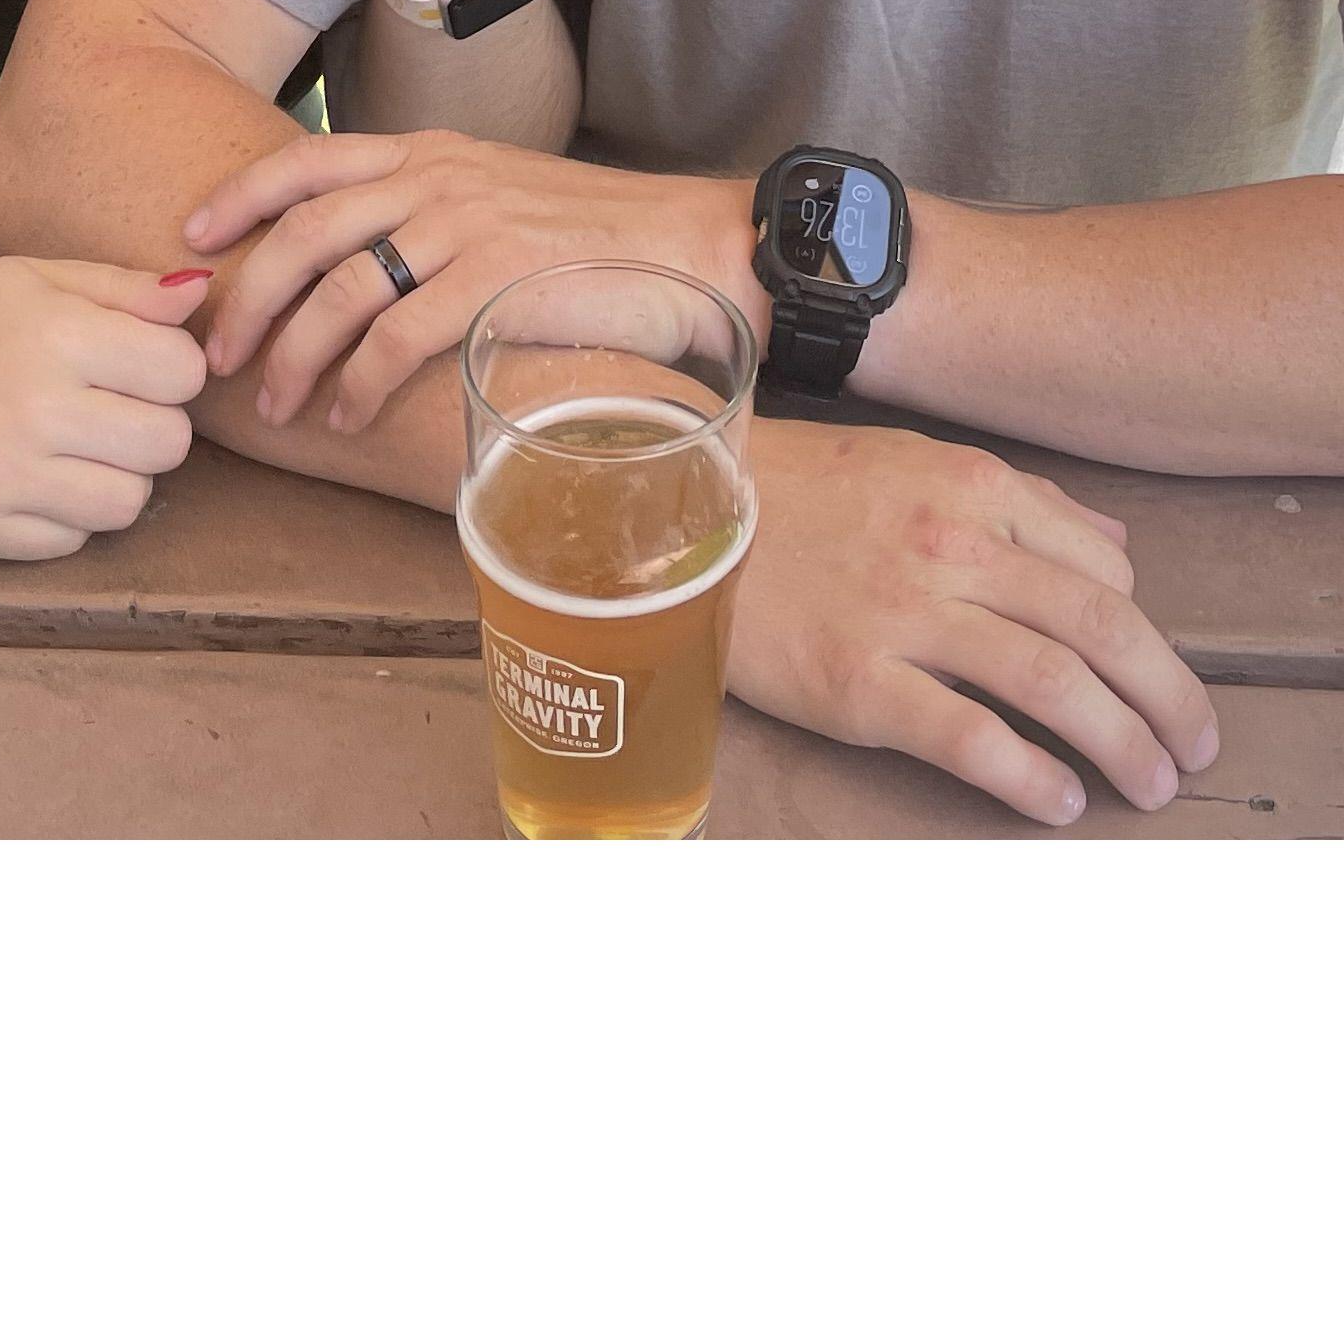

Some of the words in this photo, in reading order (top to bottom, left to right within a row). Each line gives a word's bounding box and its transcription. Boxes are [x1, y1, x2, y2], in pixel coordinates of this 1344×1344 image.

[490, 641, 605, 711] TERMINAL
[495, 671, 603, 739] GRAVITY
[552, 734, 600, 749] OREGON
